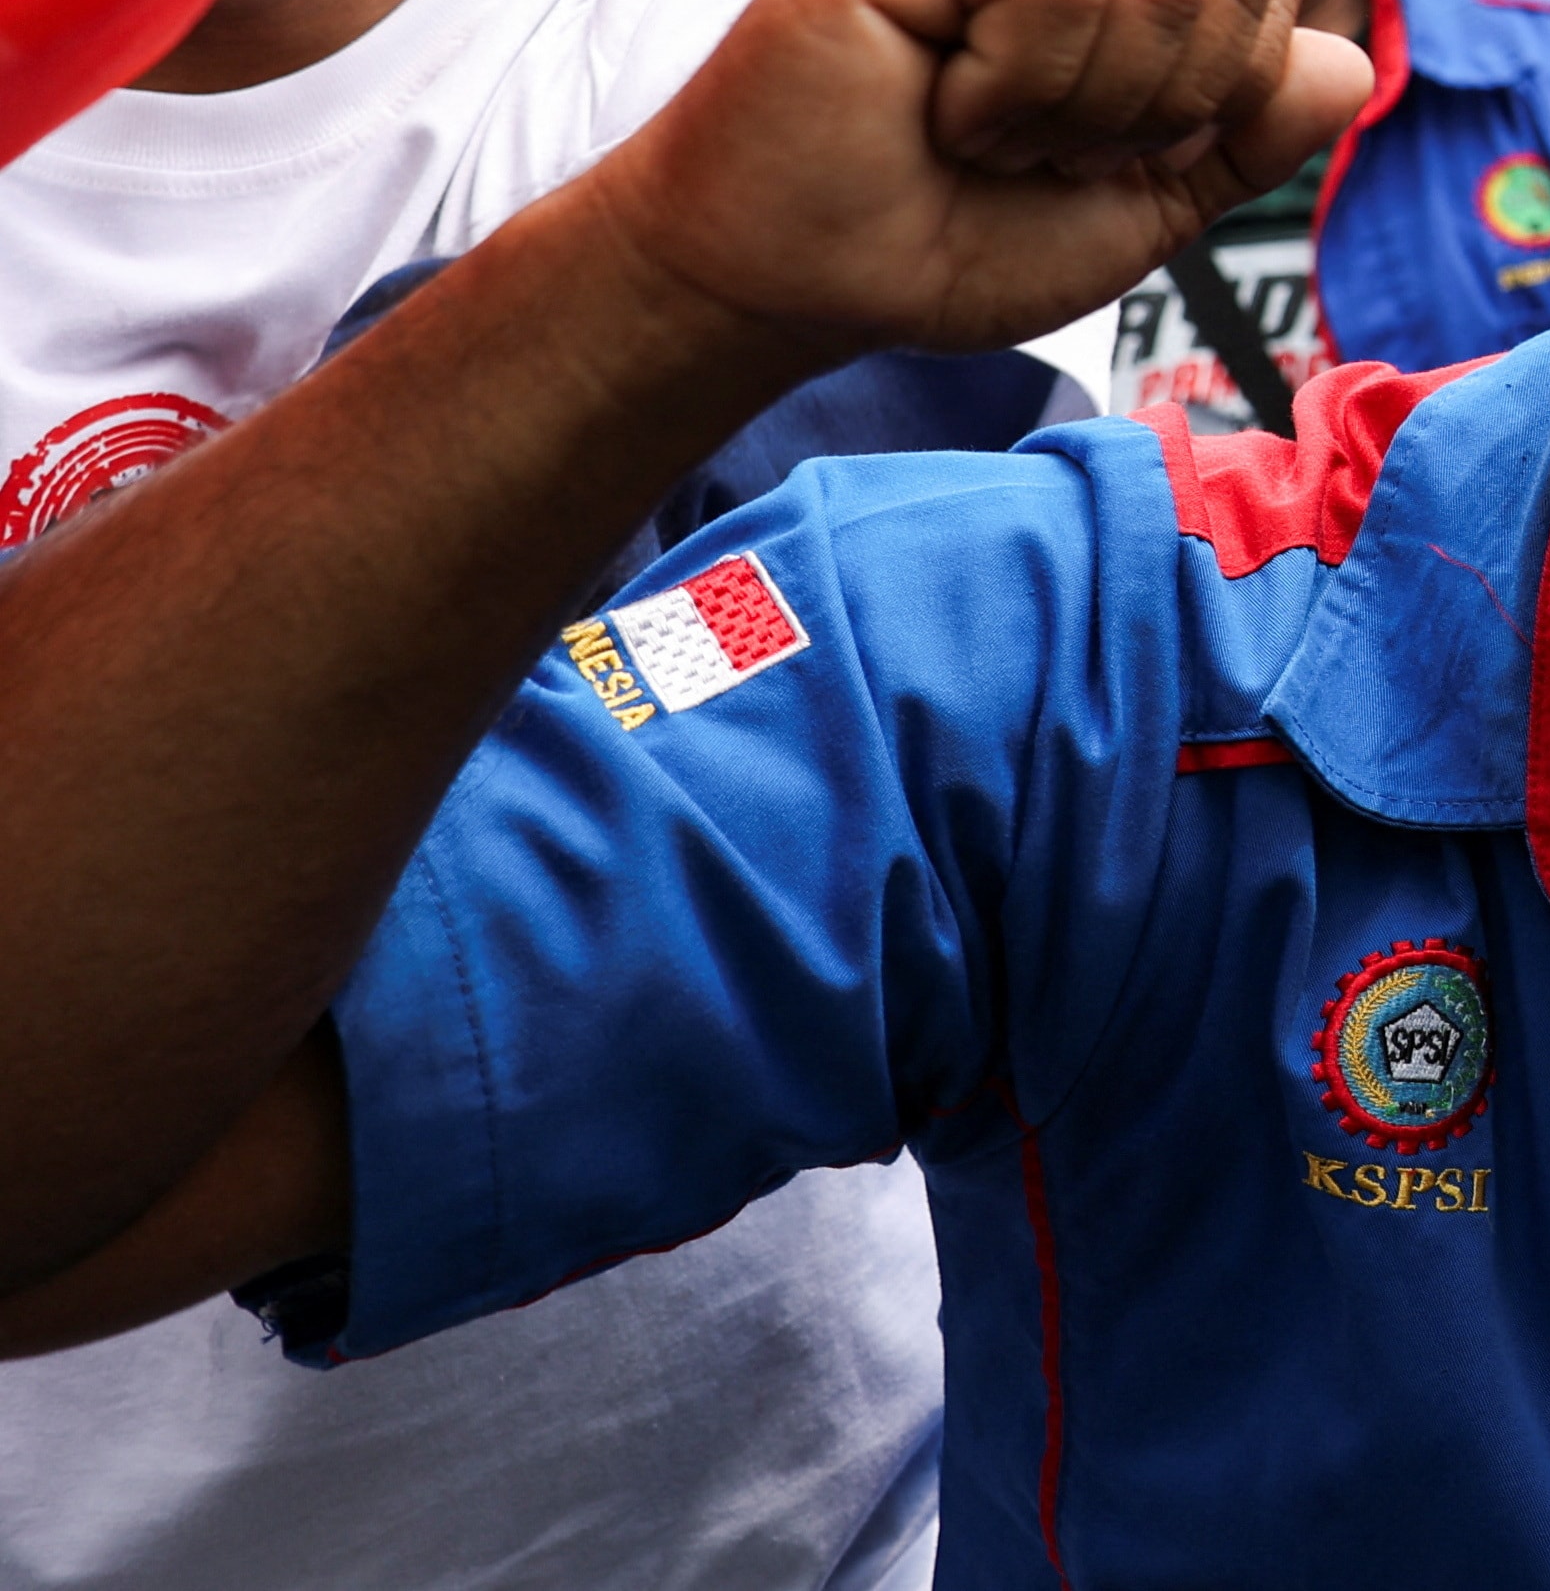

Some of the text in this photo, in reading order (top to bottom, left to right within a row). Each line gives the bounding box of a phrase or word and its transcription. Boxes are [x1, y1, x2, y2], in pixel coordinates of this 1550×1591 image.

[561, 617, 656, 732] NESIA
[1387, 1028, 1451, 1065] SPSI
[1302, 1150, 1492, 1212] KSPSI
